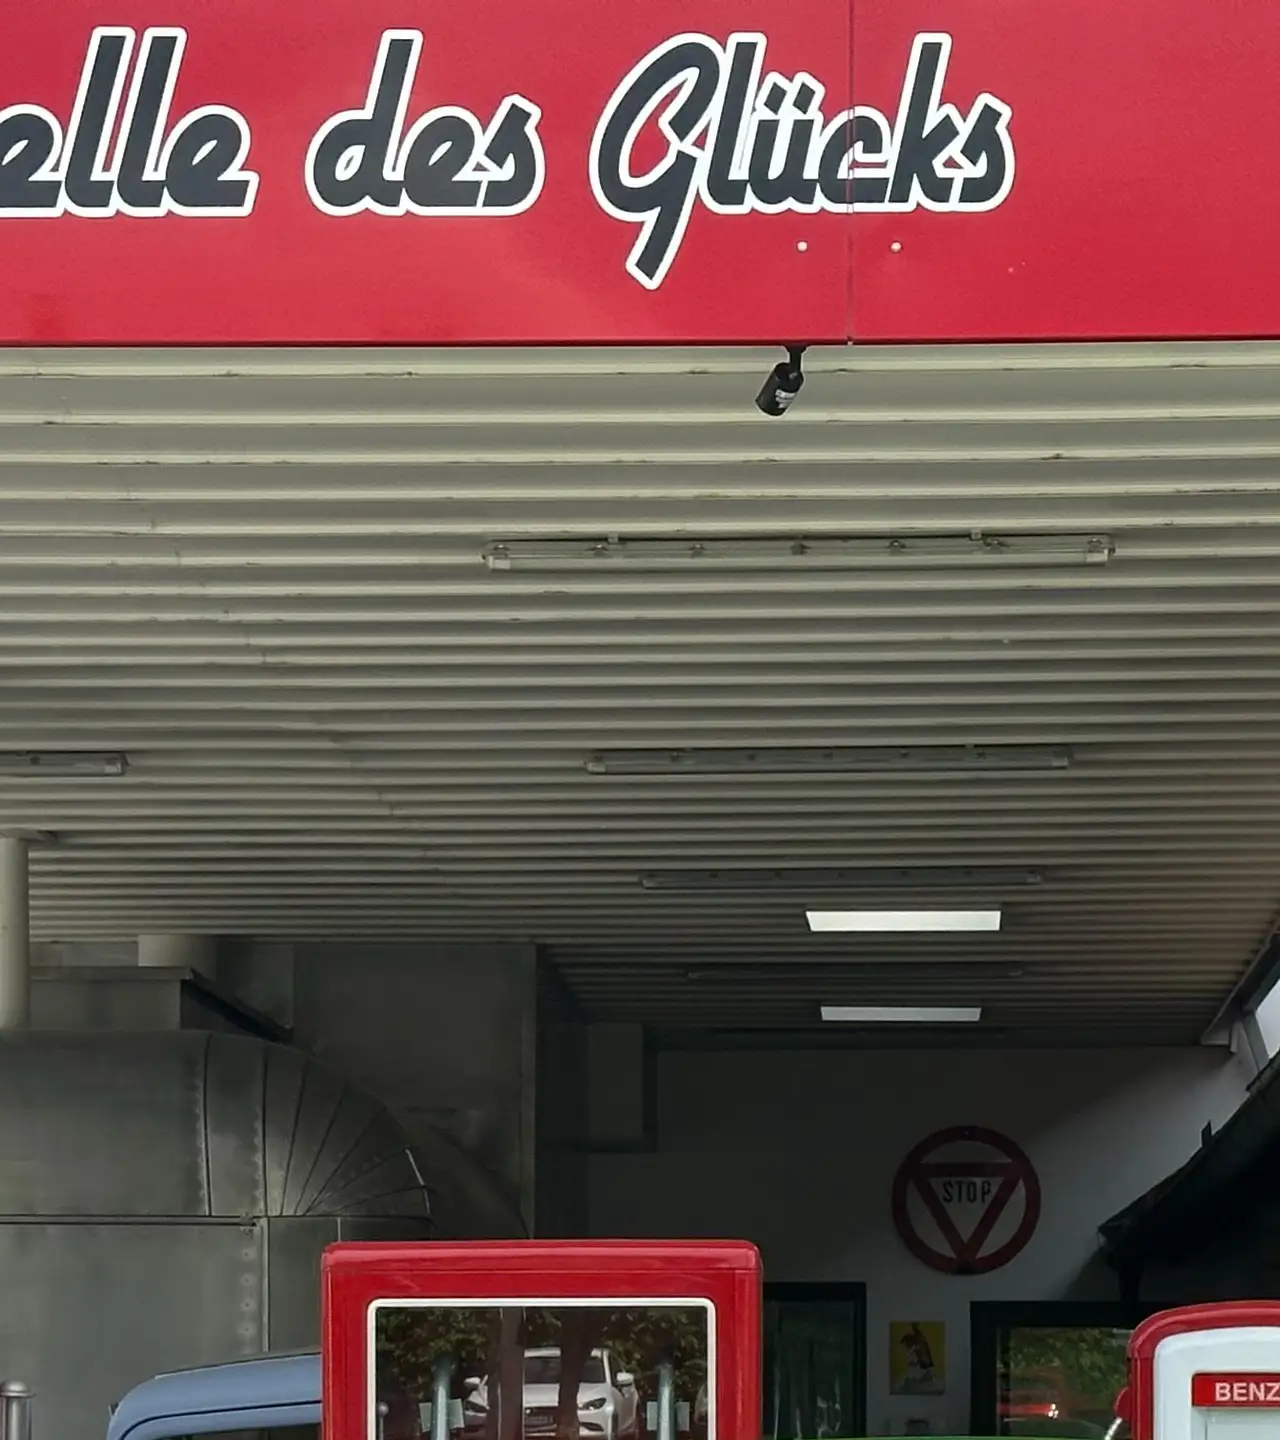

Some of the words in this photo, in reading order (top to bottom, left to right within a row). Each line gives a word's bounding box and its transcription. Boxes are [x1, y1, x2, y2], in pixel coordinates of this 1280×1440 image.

[304, 29, 545, 215] des
[589, 32, 1016, 290] Glücks
[942, 1180, 991, 1204] STOP
